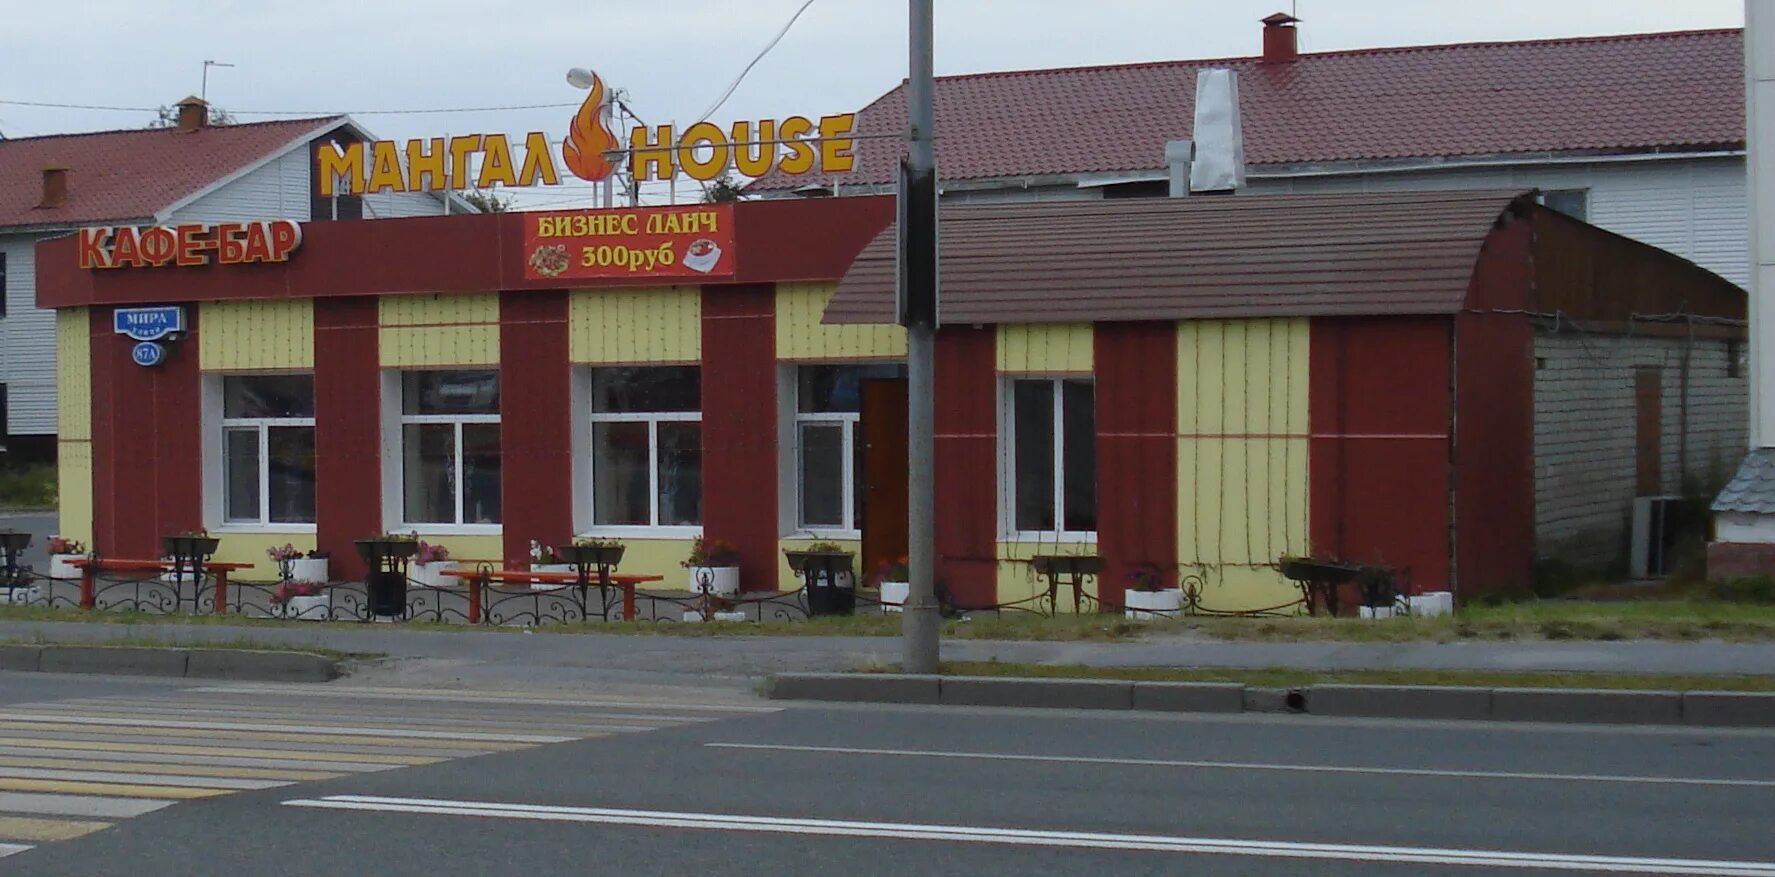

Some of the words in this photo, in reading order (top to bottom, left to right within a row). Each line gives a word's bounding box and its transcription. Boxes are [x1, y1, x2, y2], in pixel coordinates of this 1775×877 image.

[318, 132, 560, 197] МАНГАЛ
[630, 113, 857, 181] HOUSE
[538, 214, 639, 237] БИЗНЕС
[645, 212, 718, 234] ЛАНЧ
[79, 220, 301, 269] КАФЕ-БАР
[581, 240, 676, 272] 300руб
[126, 313, 168, 324] МИРА
